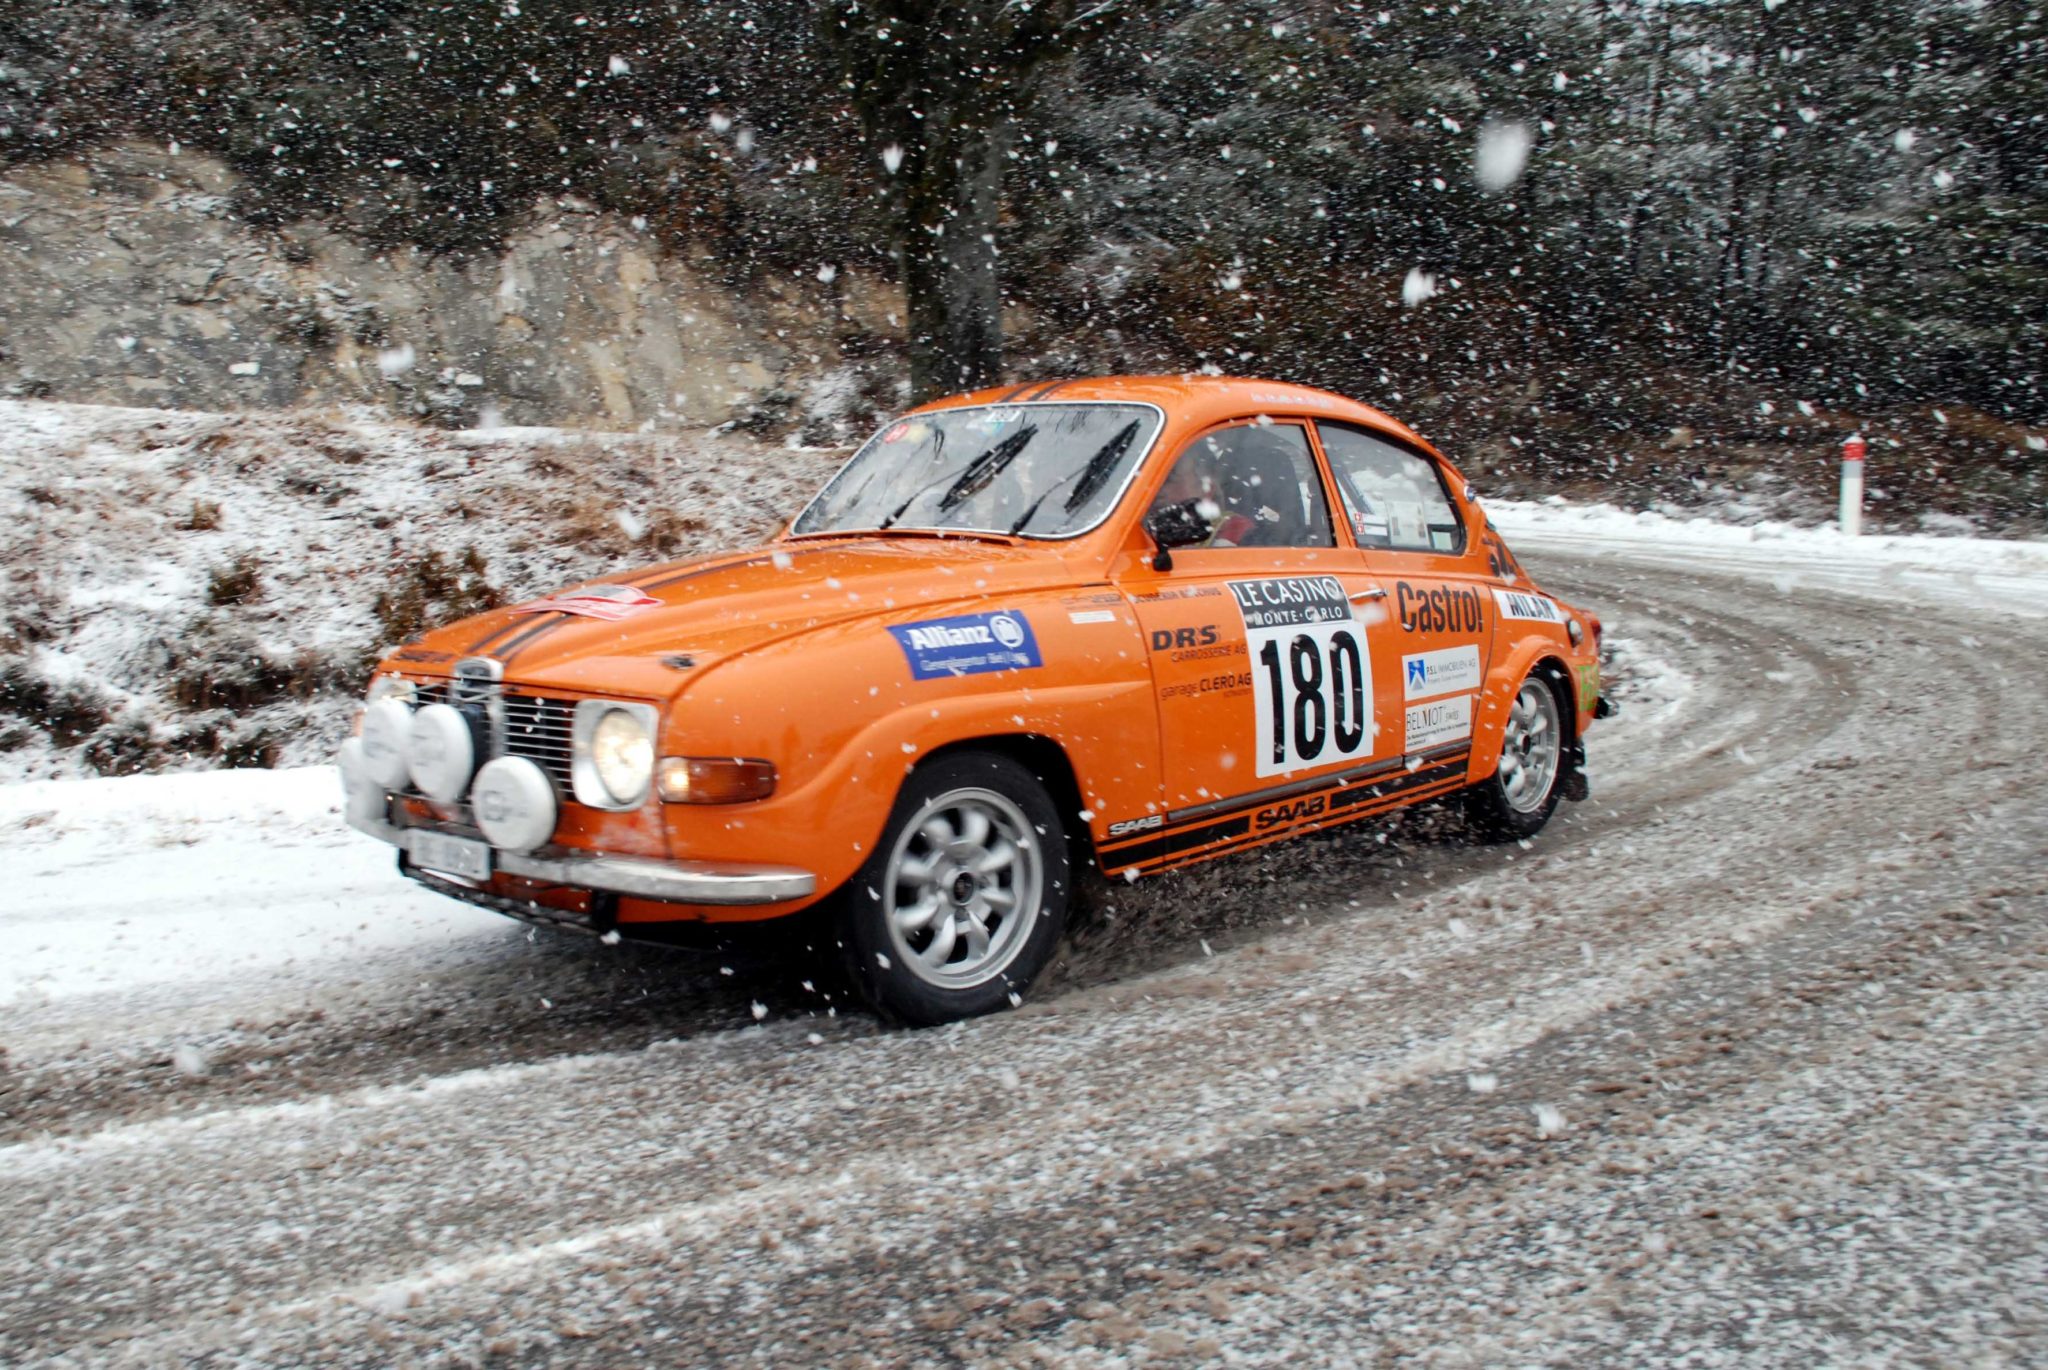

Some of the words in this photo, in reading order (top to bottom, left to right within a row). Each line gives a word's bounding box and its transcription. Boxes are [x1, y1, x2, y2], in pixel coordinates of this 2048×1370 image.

[1233, 583, 1263, 607] LE
[1261, 578, 1342, 605] CASINO
[1396, 581, 1483, 633] Castrol
[1505, 593, 1556, 619] MILAN
[906, 624, 994, 650] Allianz
[1152, 625, 1217, 651] DRS
[1199, 674, 1235, 693] CLERO
[1237, 672, 1252, 688] AG
[1260, 630, 1365, 765] 180
[1406, 705, 1444, 732] BELMOT
[1109, 816, 1162, 836] SAAB
[1255, 796, 1326, 830] SAAB
